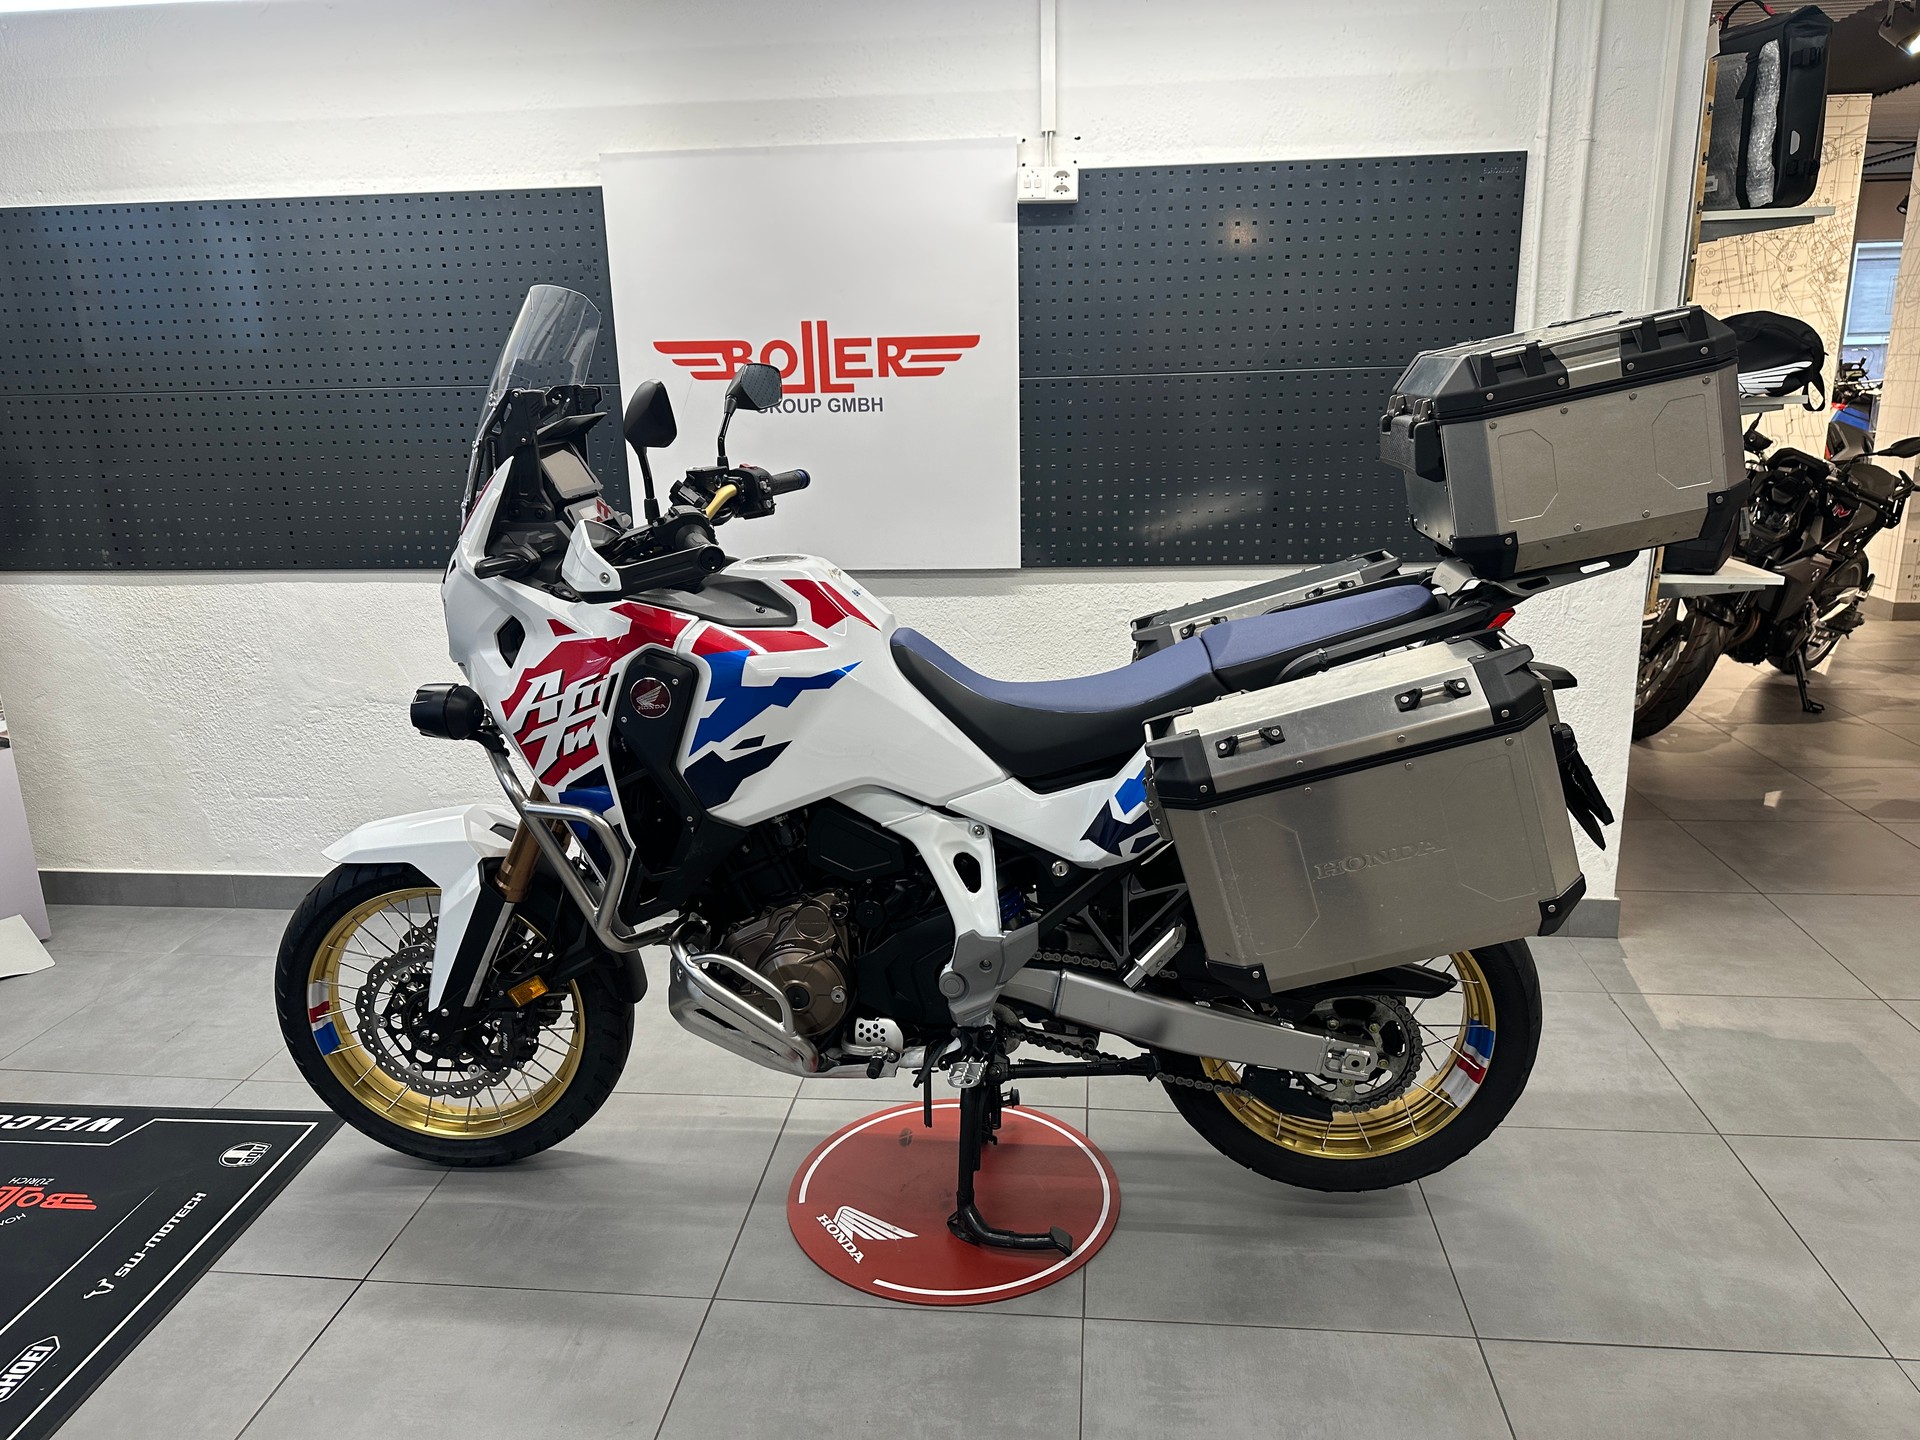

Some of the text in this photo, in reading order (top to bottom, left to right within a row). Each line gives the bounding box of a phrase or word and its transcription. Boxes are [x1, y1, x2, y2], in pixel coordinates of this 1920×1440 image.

[708, 320, 918, 394] BOLLER
[827, 397, 884, 412] GMBH
[1314, 839, 1447, 880] HONDA
[0, 1114, 124, 1132] WELC
[8, 1177, 55, 1186] ZÜRICH
[816, 1213, 865, 1264] HONDA
